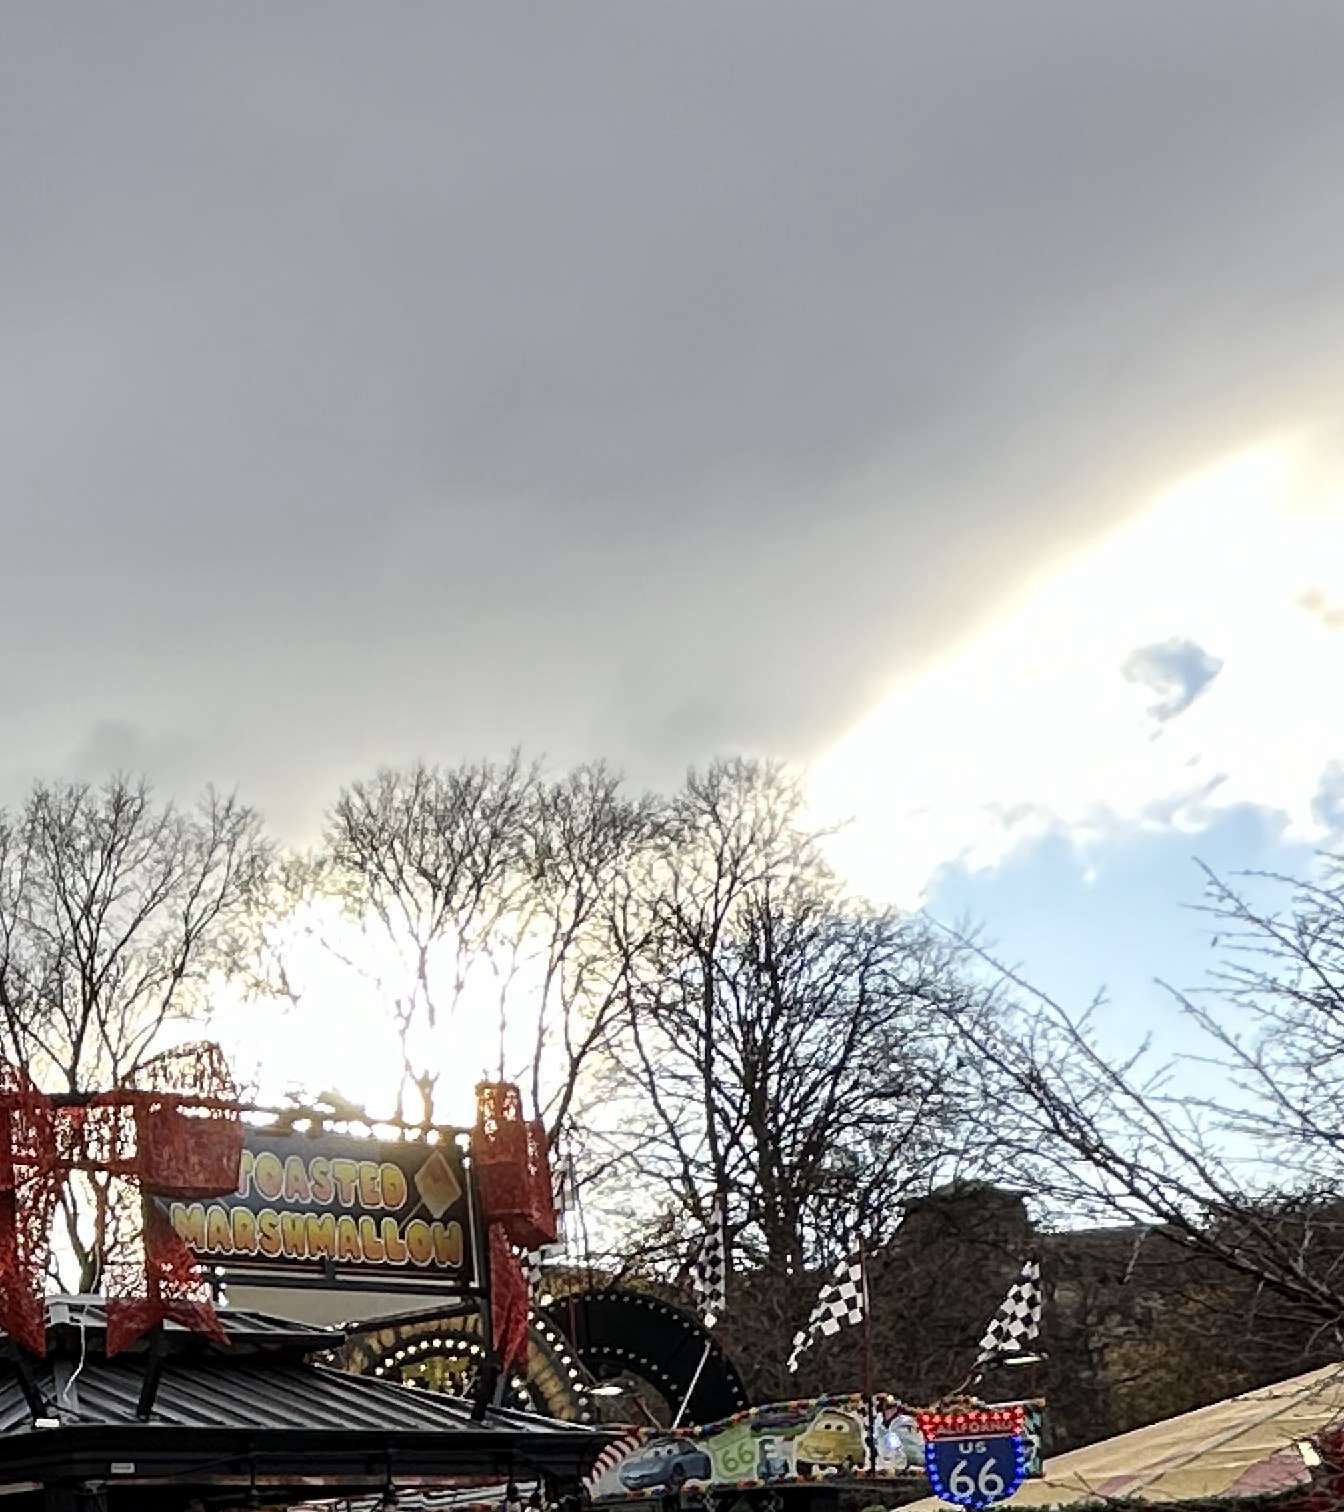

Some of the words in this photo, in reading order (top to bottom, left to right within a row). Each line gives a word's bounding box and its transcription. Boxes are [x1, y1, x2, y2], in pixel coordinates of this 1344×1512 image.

[170, 1202, 465, 1269] MARSHMALLOW
[722, 1441, 755, 1473] 66
[958, 1441, 987, 1454] US
[949, 1457, 1004, 1498] 66
